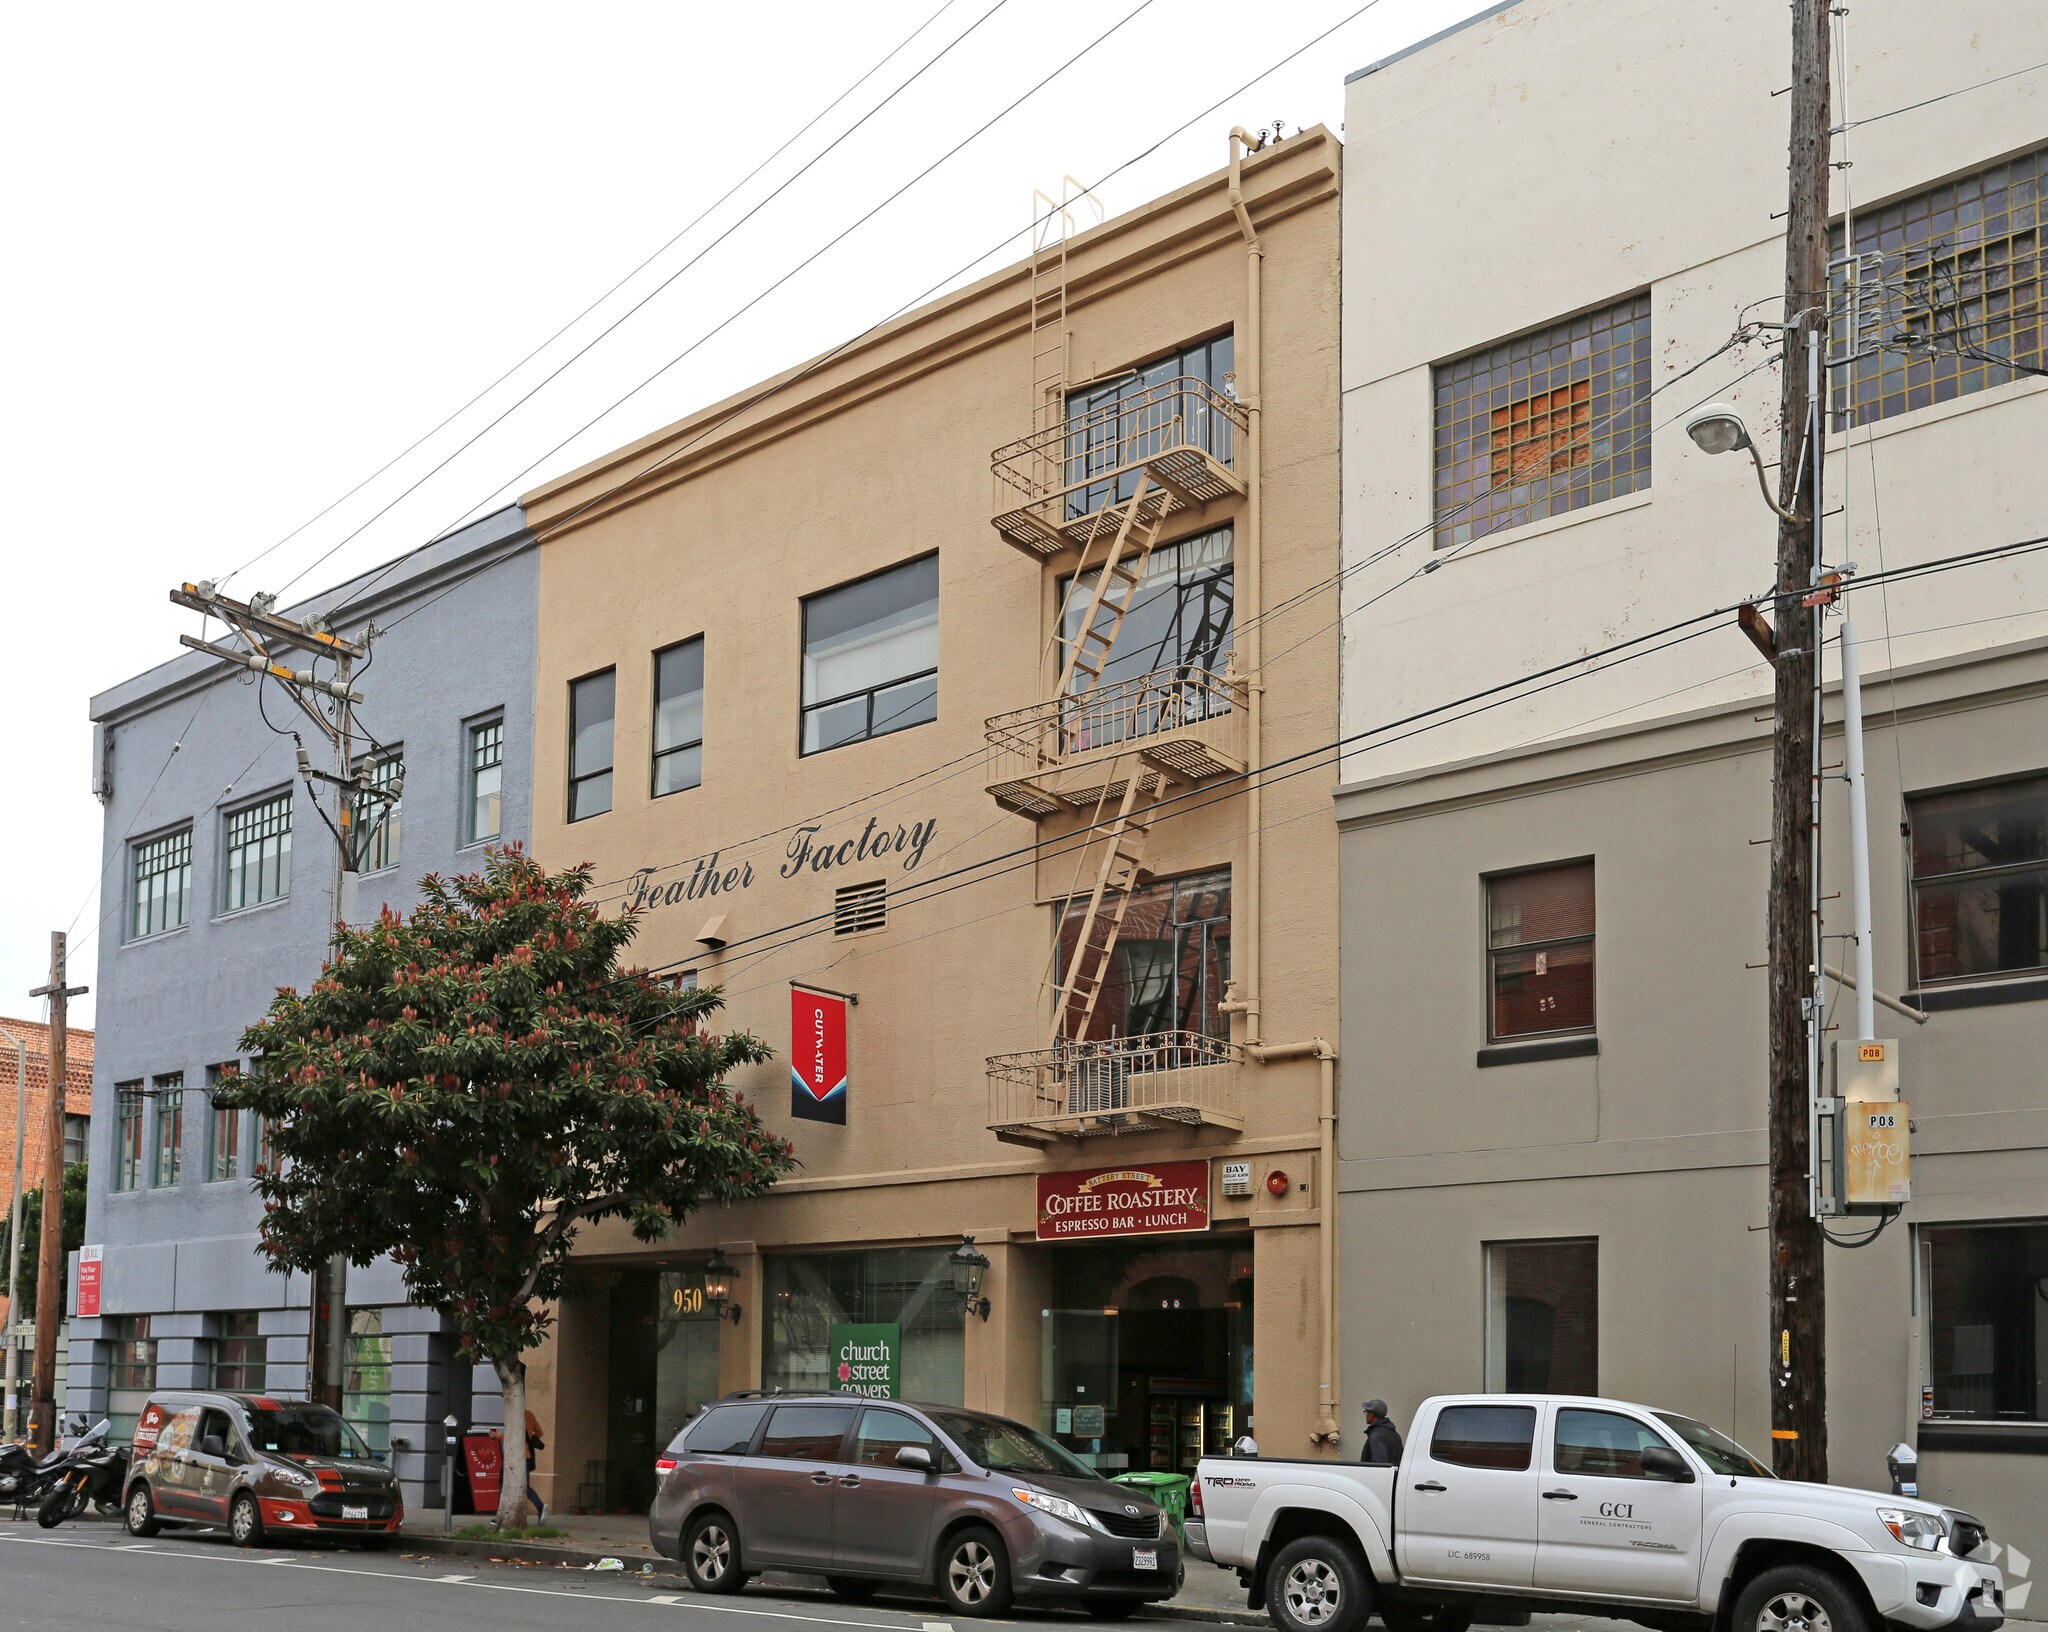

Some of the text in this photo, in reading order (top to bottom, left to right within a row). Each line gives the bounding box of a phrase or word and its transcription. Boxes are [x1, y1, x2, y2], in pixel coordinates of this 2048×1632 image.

[622, 816, 938, 912] Feather Factory
[814, 1008, 824, 1083] CUTWATER
[1226, 1165, 1246, 1173] BAY
[1088, 1172, 1151, 1186] BATTERY STREET
[1045, 1187, 1199, 1215] COFFEE ROASTERY
[1055, 1212, 1187, 1233] ESPRESSO BAR LUNCH
[673, 1288, 702, 1314] 950
[16, 1326, 34, 1334] BATTER
[840, 1340, 890, 1361] church
[851, 1363, 891, 1381] street
[1204, 1476, 1234, 1487] TRD
[1599, 1502, 1634, 1518] GCI
[1608, 1522, 1652, 1530] CONTRACTORS
[1629, 1540, 1677, 1550] TACOMA
[1447, 1550, 1491, 1561] LIC. 689958
